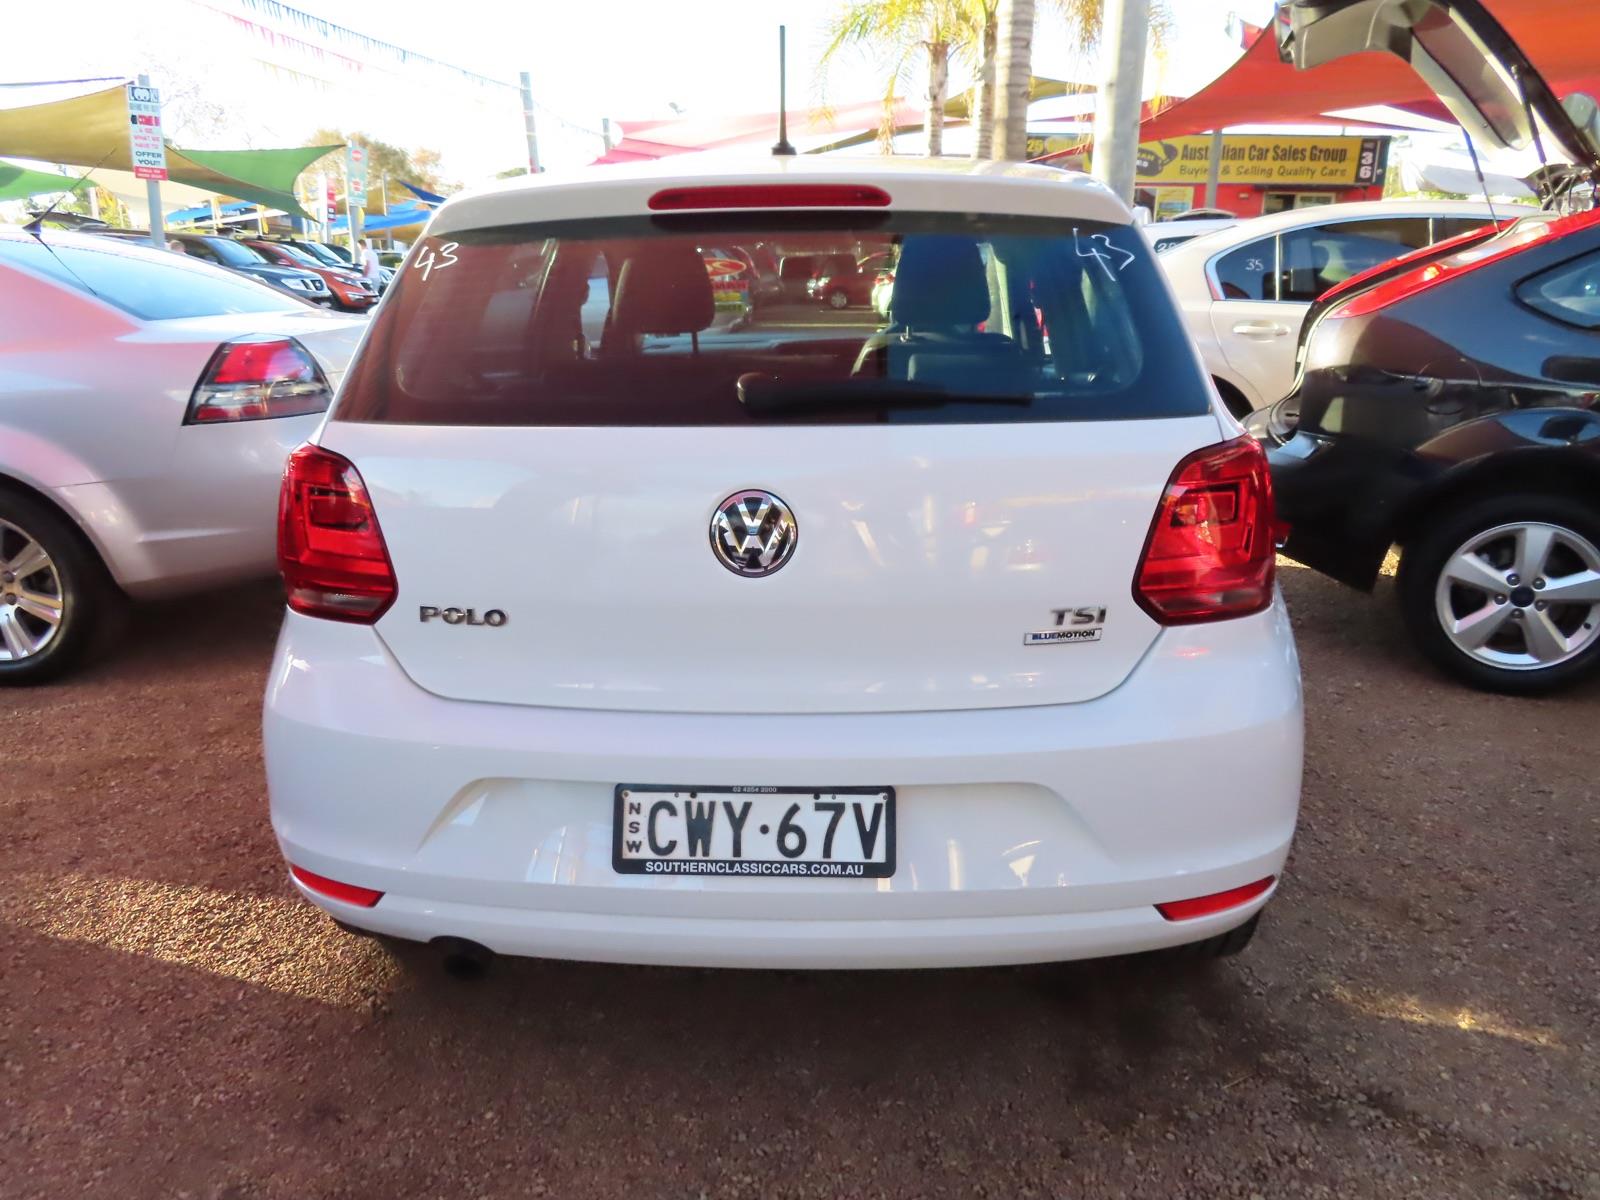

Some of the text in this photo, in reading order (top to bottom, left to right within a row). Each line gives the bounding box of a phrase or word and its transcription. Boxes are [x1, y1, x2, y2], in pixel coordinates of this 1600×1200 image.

[135, 150, 162, 158] OFFER
[1181, 144, 1245, 161] Austlian
[1248, 144, 1270, 161] Car
[1272, 144, 1307, 162] Sales
[1309, 145, 1347, 164] Group
[1180, 165, 1212, 178] Buyin
[1236, 165, 1273, 178] Selling
[1277, 165, 1316, 179] Quality
[1320, 165, 1347, 177] Cars
[413, 242, 460, 281] 43
[1073, 227, 1135, 281] 43
[1244, 258, 1265, 271] 35
[419, 605, 507, 627] POLO
[1051, 606, 1107, 626] TSI
[1032, 630, 1095, 640] BLUEMOTION
[645, 861, 864, 876] SOUTHERNCLASSICCARS.COM.AU
